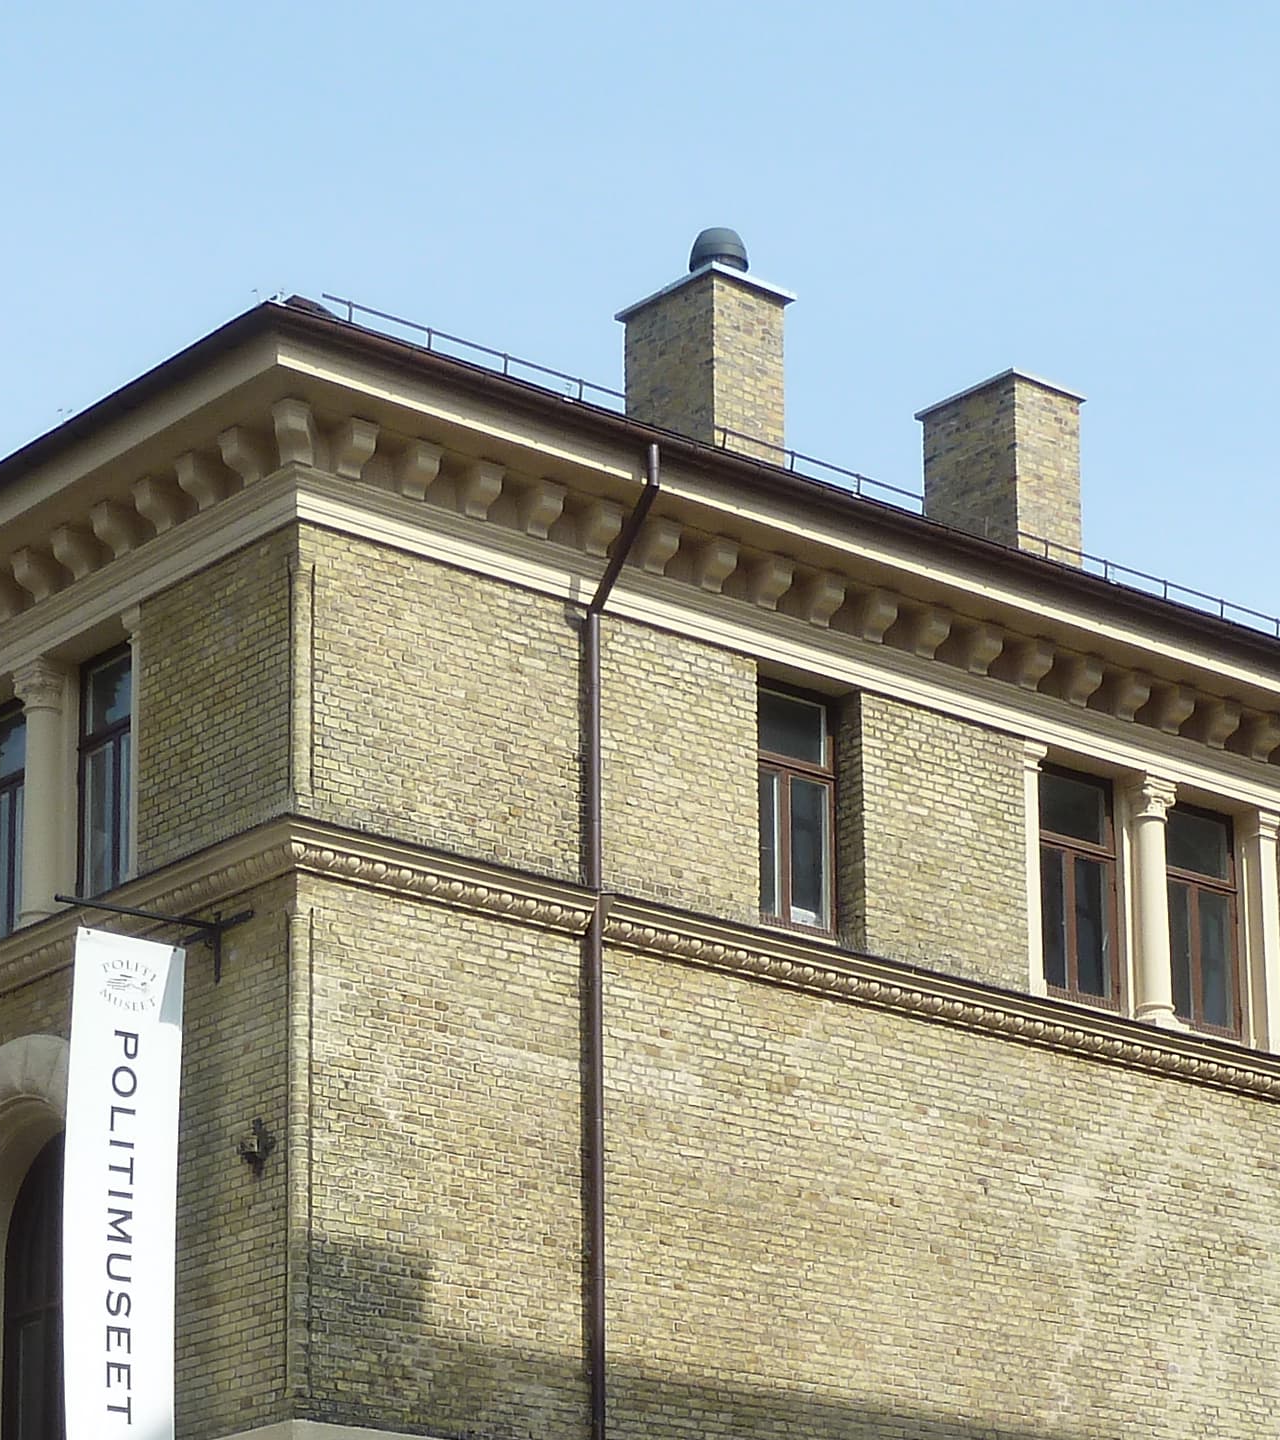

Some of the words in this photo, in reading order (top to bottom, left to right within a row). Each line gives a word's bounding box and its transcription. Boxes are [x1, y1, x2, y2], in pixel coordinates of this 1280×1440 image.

[102, 959, 157, 982] POLITI
[98, 988, 157, 1012] MUSEET
[105, 1029, 139, 1426] POLITIMUSEET
